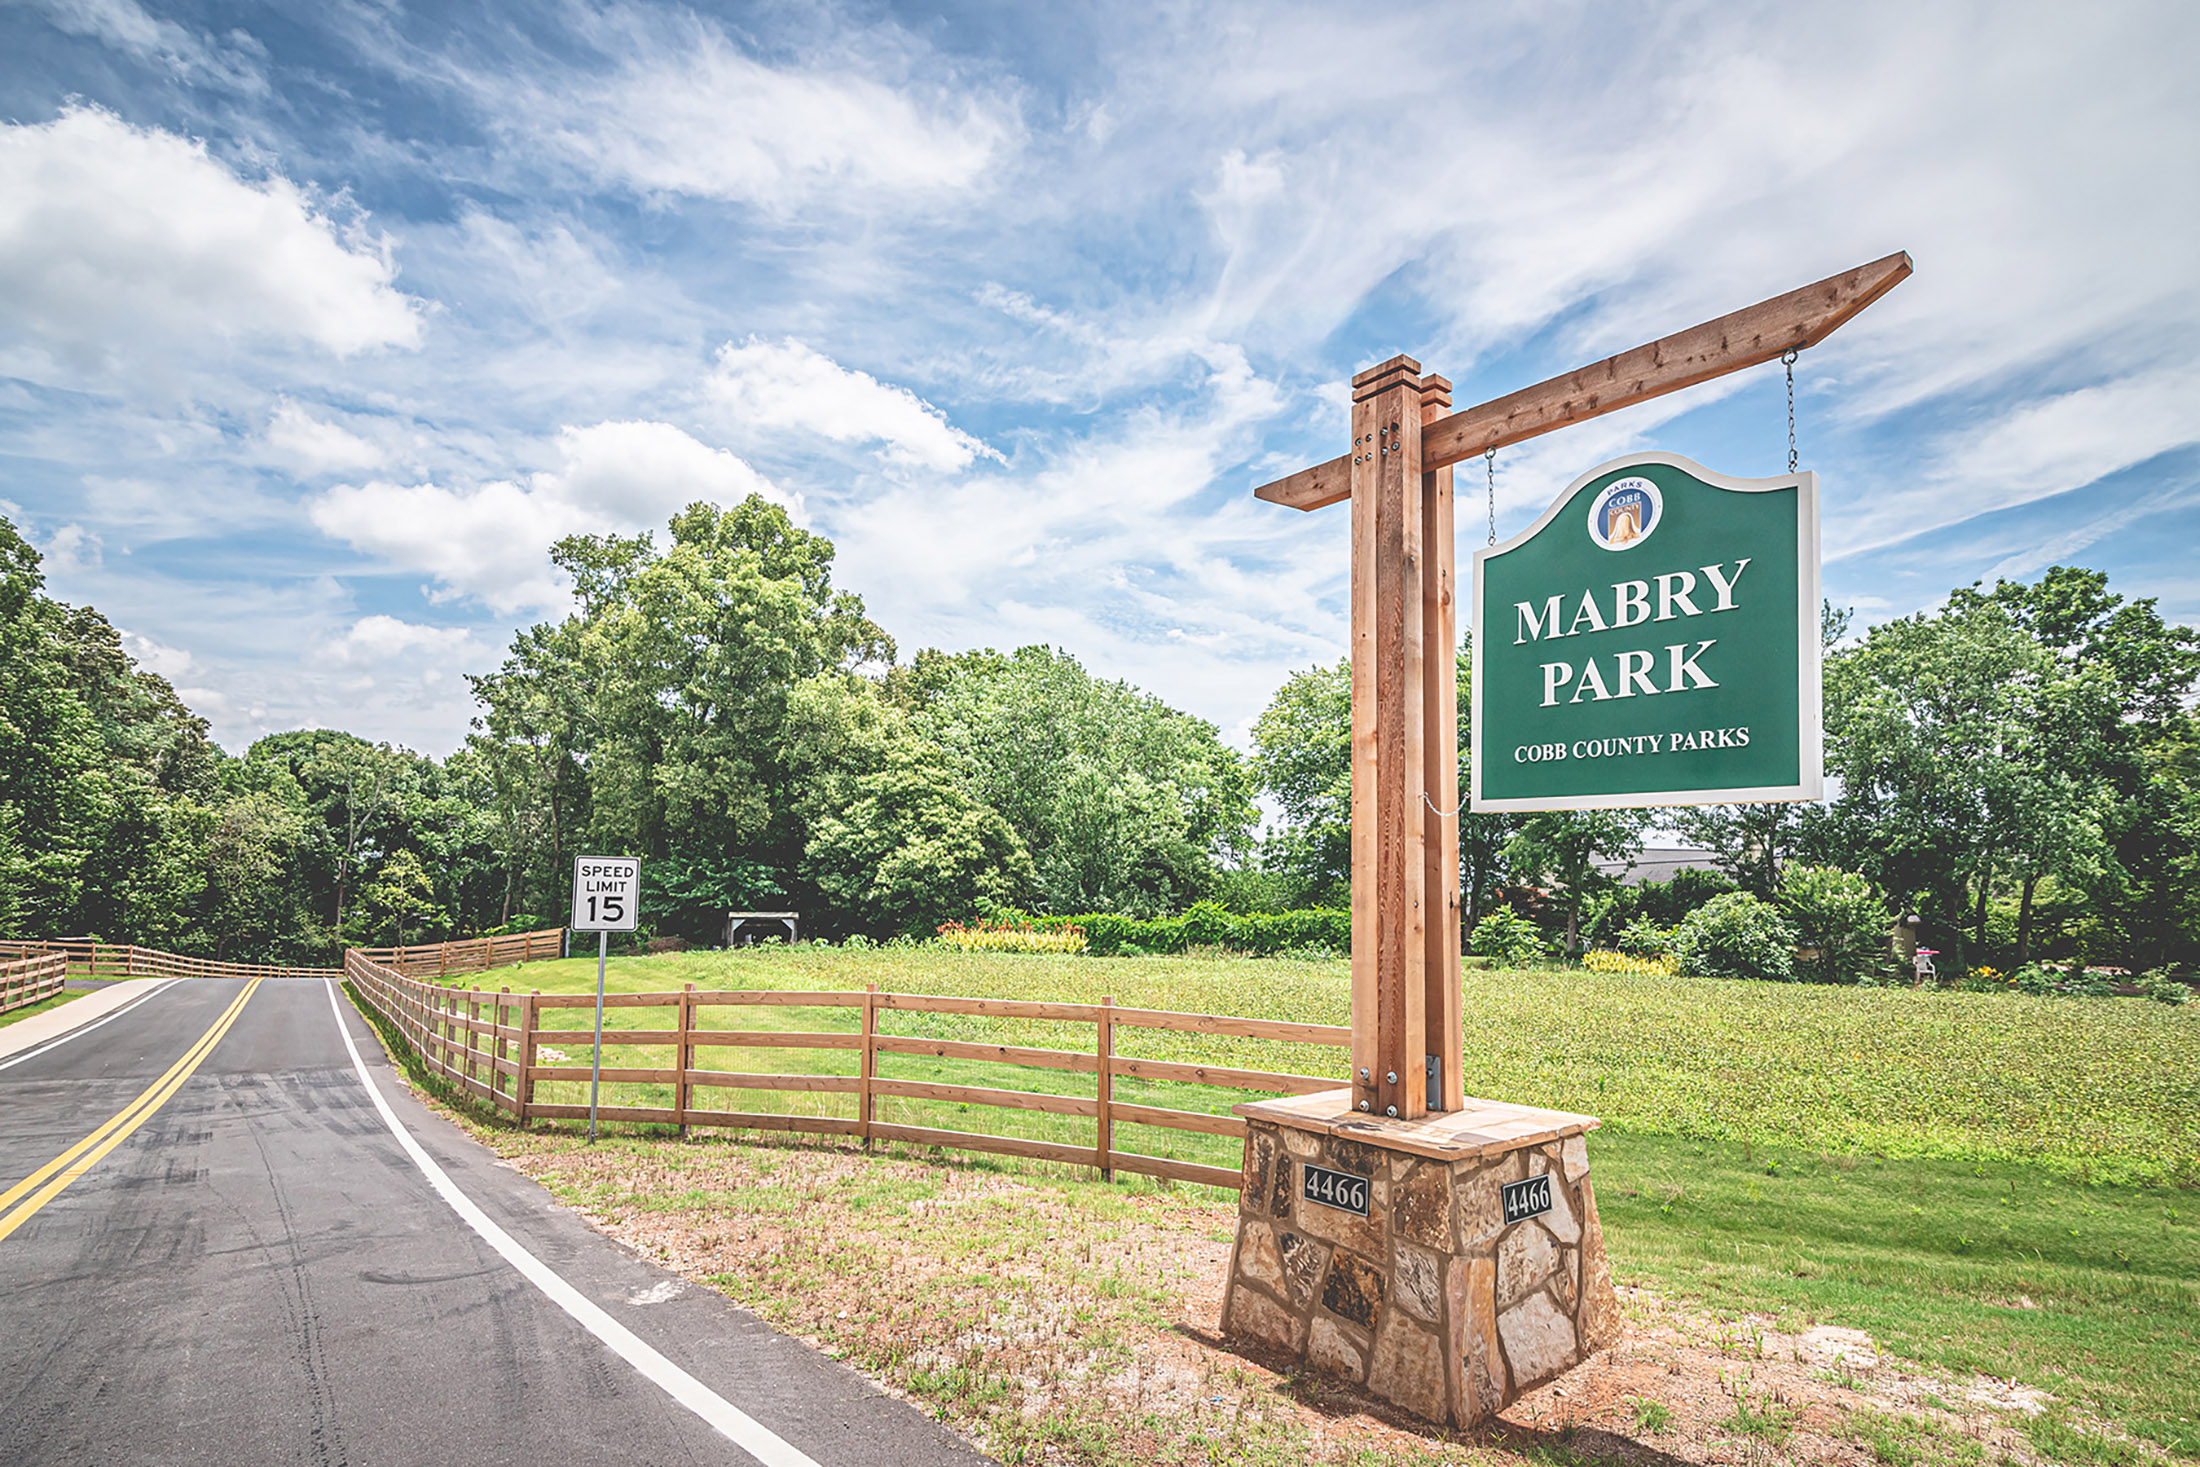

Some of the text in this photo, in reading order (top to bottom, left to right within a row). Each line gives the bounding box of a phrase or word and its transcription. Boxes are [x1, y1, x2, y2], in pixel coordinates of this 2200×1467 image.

[1607, 481, 1643, 495] PARKS
[1608, 492, 1641, 508] COBB
[1513, 558, 1752, 645] MABRY
[1539, 640, 1719, 707] PARK
[1514, 727, 1750, 763] COBB COUNTY PARKS
[581, 865, 634, 878] SPEED
[586, 880, 627, 892] LIMIT
[587, 896, 624, 922] 15
[1306, 1170, 1364, 1210] 4466
[1508, 1179, 1549, 1217] 4466
